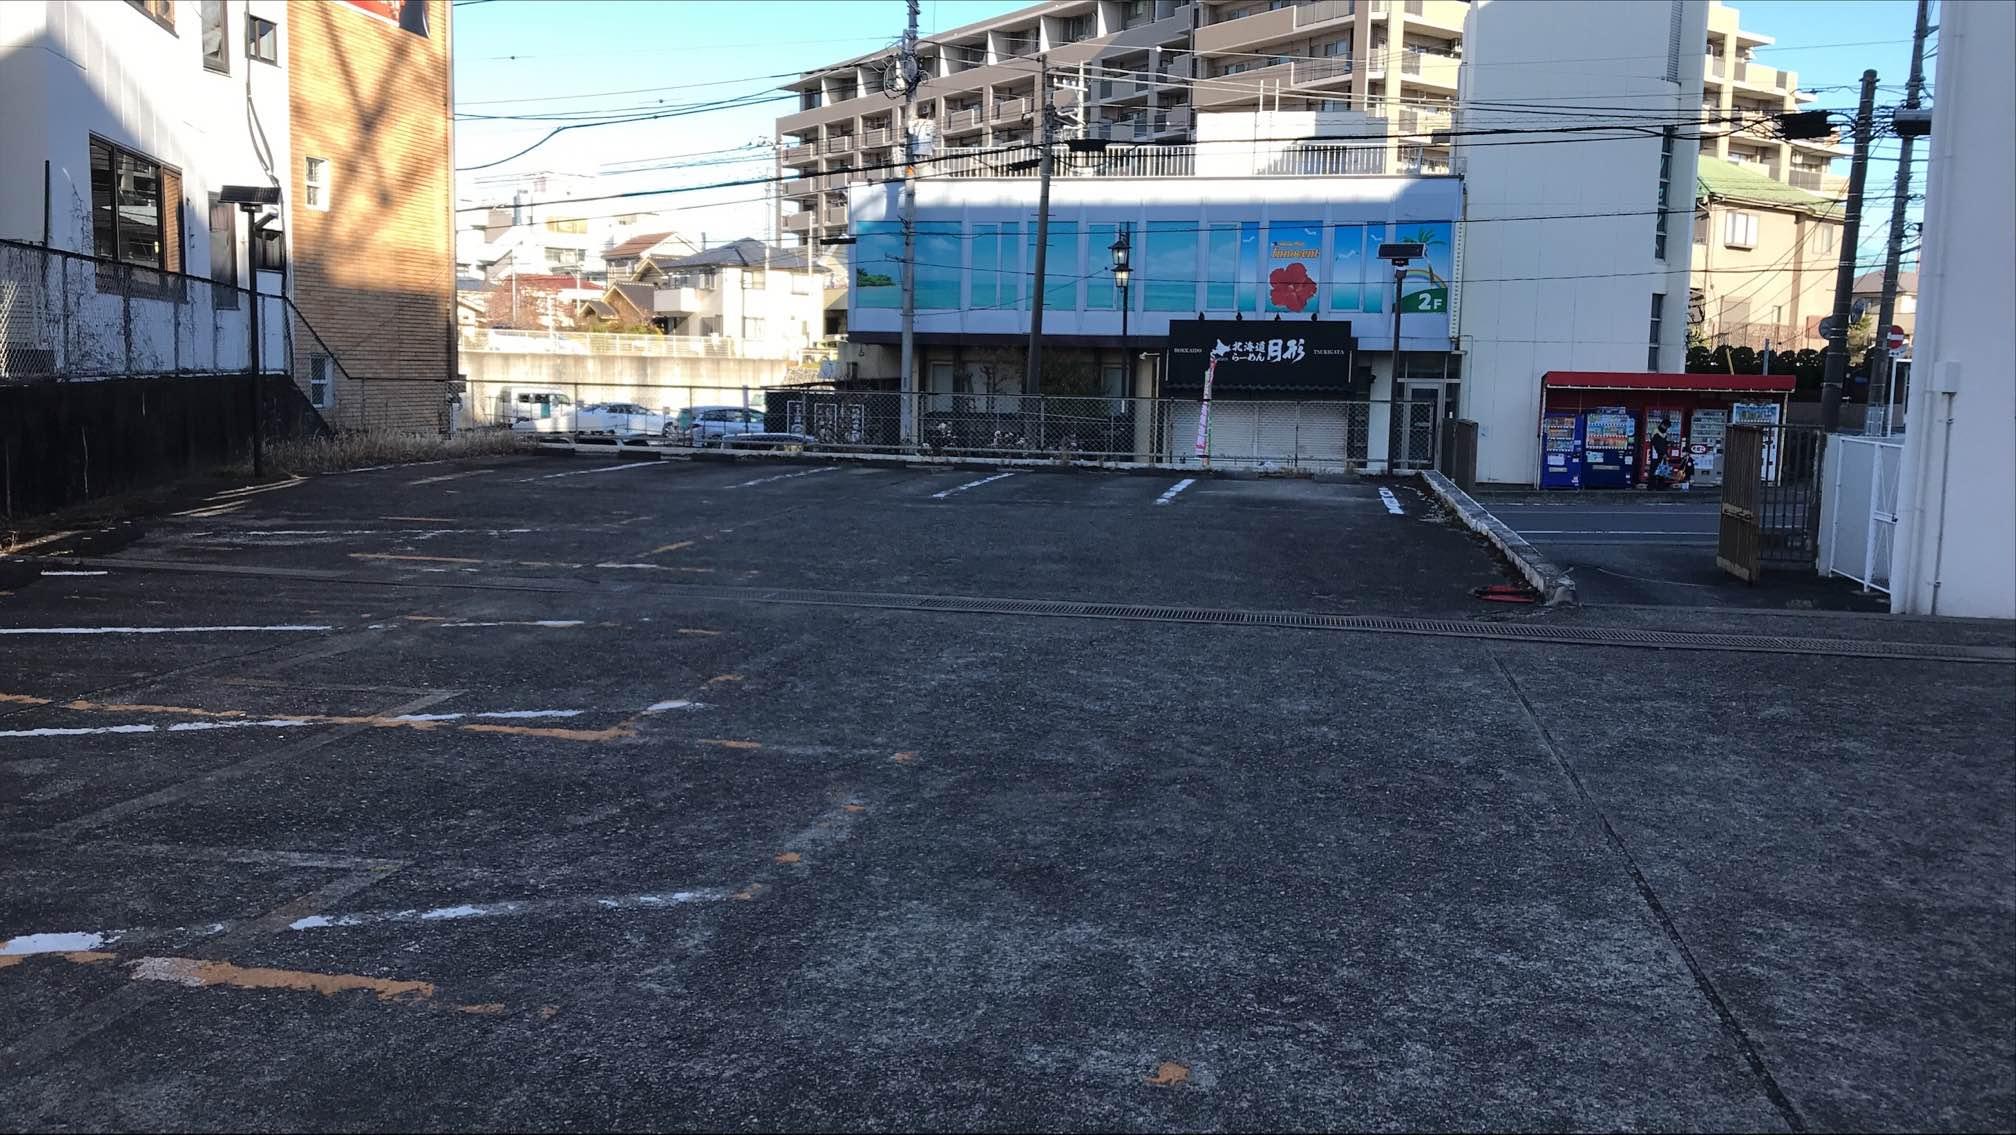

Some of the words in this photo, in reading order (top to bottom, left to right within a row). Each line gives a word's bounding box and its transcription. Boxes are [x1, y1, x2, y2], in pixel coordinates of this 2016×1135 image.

[1418, 292, 1443, 310] 2F
[1232, 341, 1266, 352] 北海道
[1267, 338, 1305, 364] 月形
[1232, 353, 1265, 362] らーめん
